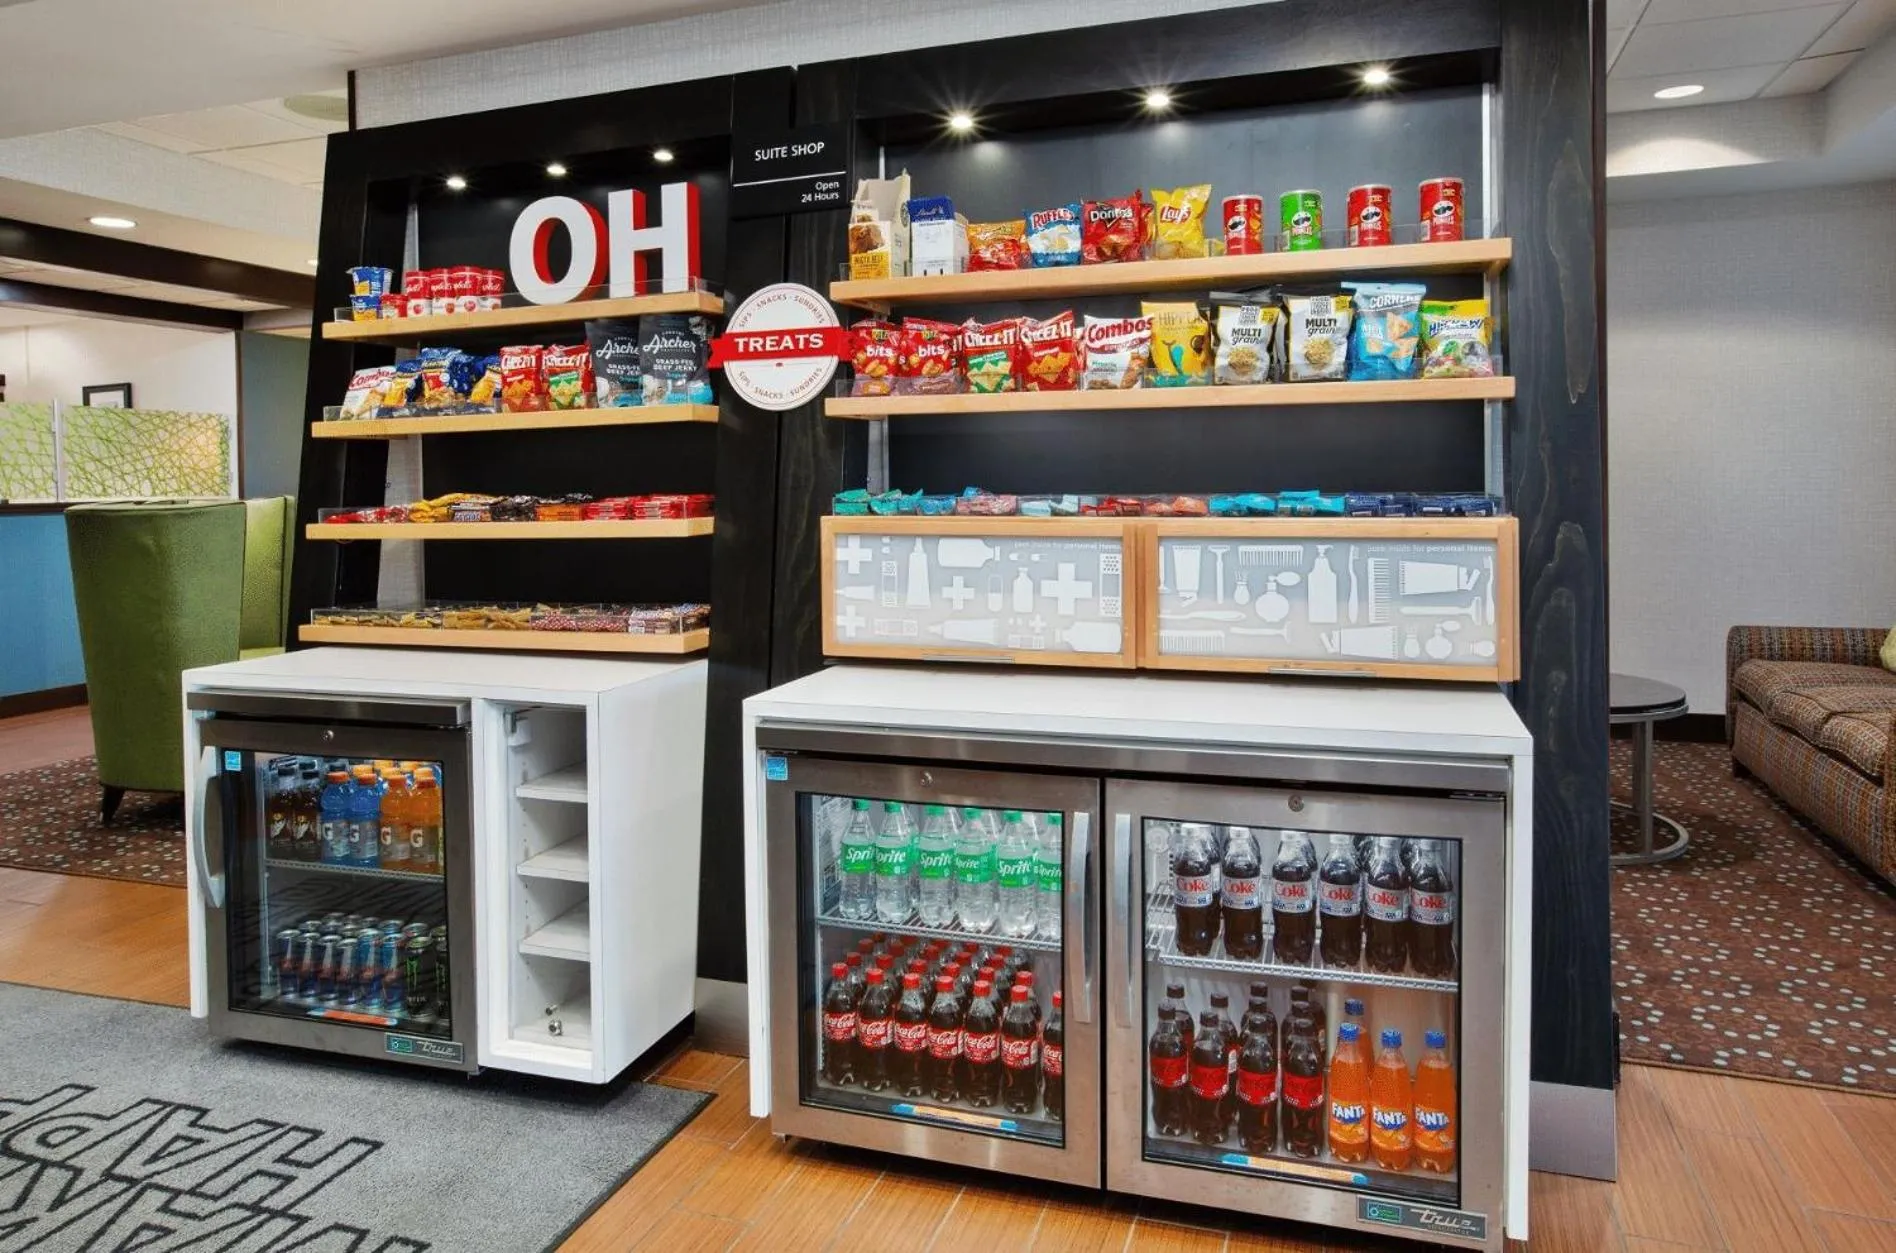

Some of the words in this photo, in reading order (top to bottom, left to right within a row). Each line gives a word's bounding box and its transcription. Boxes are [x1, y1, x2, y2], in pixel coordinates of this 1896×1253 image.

[755, 146, 788, 161] SUITE
[791, 142, 825, 156] SHOP
[815, 181, 839, 191] Open
[801, 193, 812, 203] 24
[814, 191, 840, 201] Hours
[1032, 208, 1074, 229] RUFFLES
[1090, 207, 1133, 222] Doritos
[509, 182, 702, 305] OH
[756, 293, 788, 310] SNACKS
[794, 295, 826, 325] SUNDRIES
[1305, 318, 1338, 328] MULTI
[1231, 327, 1262, 337] MULTI
[1307, 327, 1338, 337] grain
[643, 333, 697, 355] Archer
[734, 333, 824, 353] TREATS
[1231, 336, 1262, 346] grain
[596, 339, 640, 360] Arche
[866, 345, 893, 357] bits
[918, 344, 945, 358] bits
[754, 386, 784, 400] SNACKS
[789, 367, 823, 397] SUNDRIES
[846, 847, 873, 863] Spri
